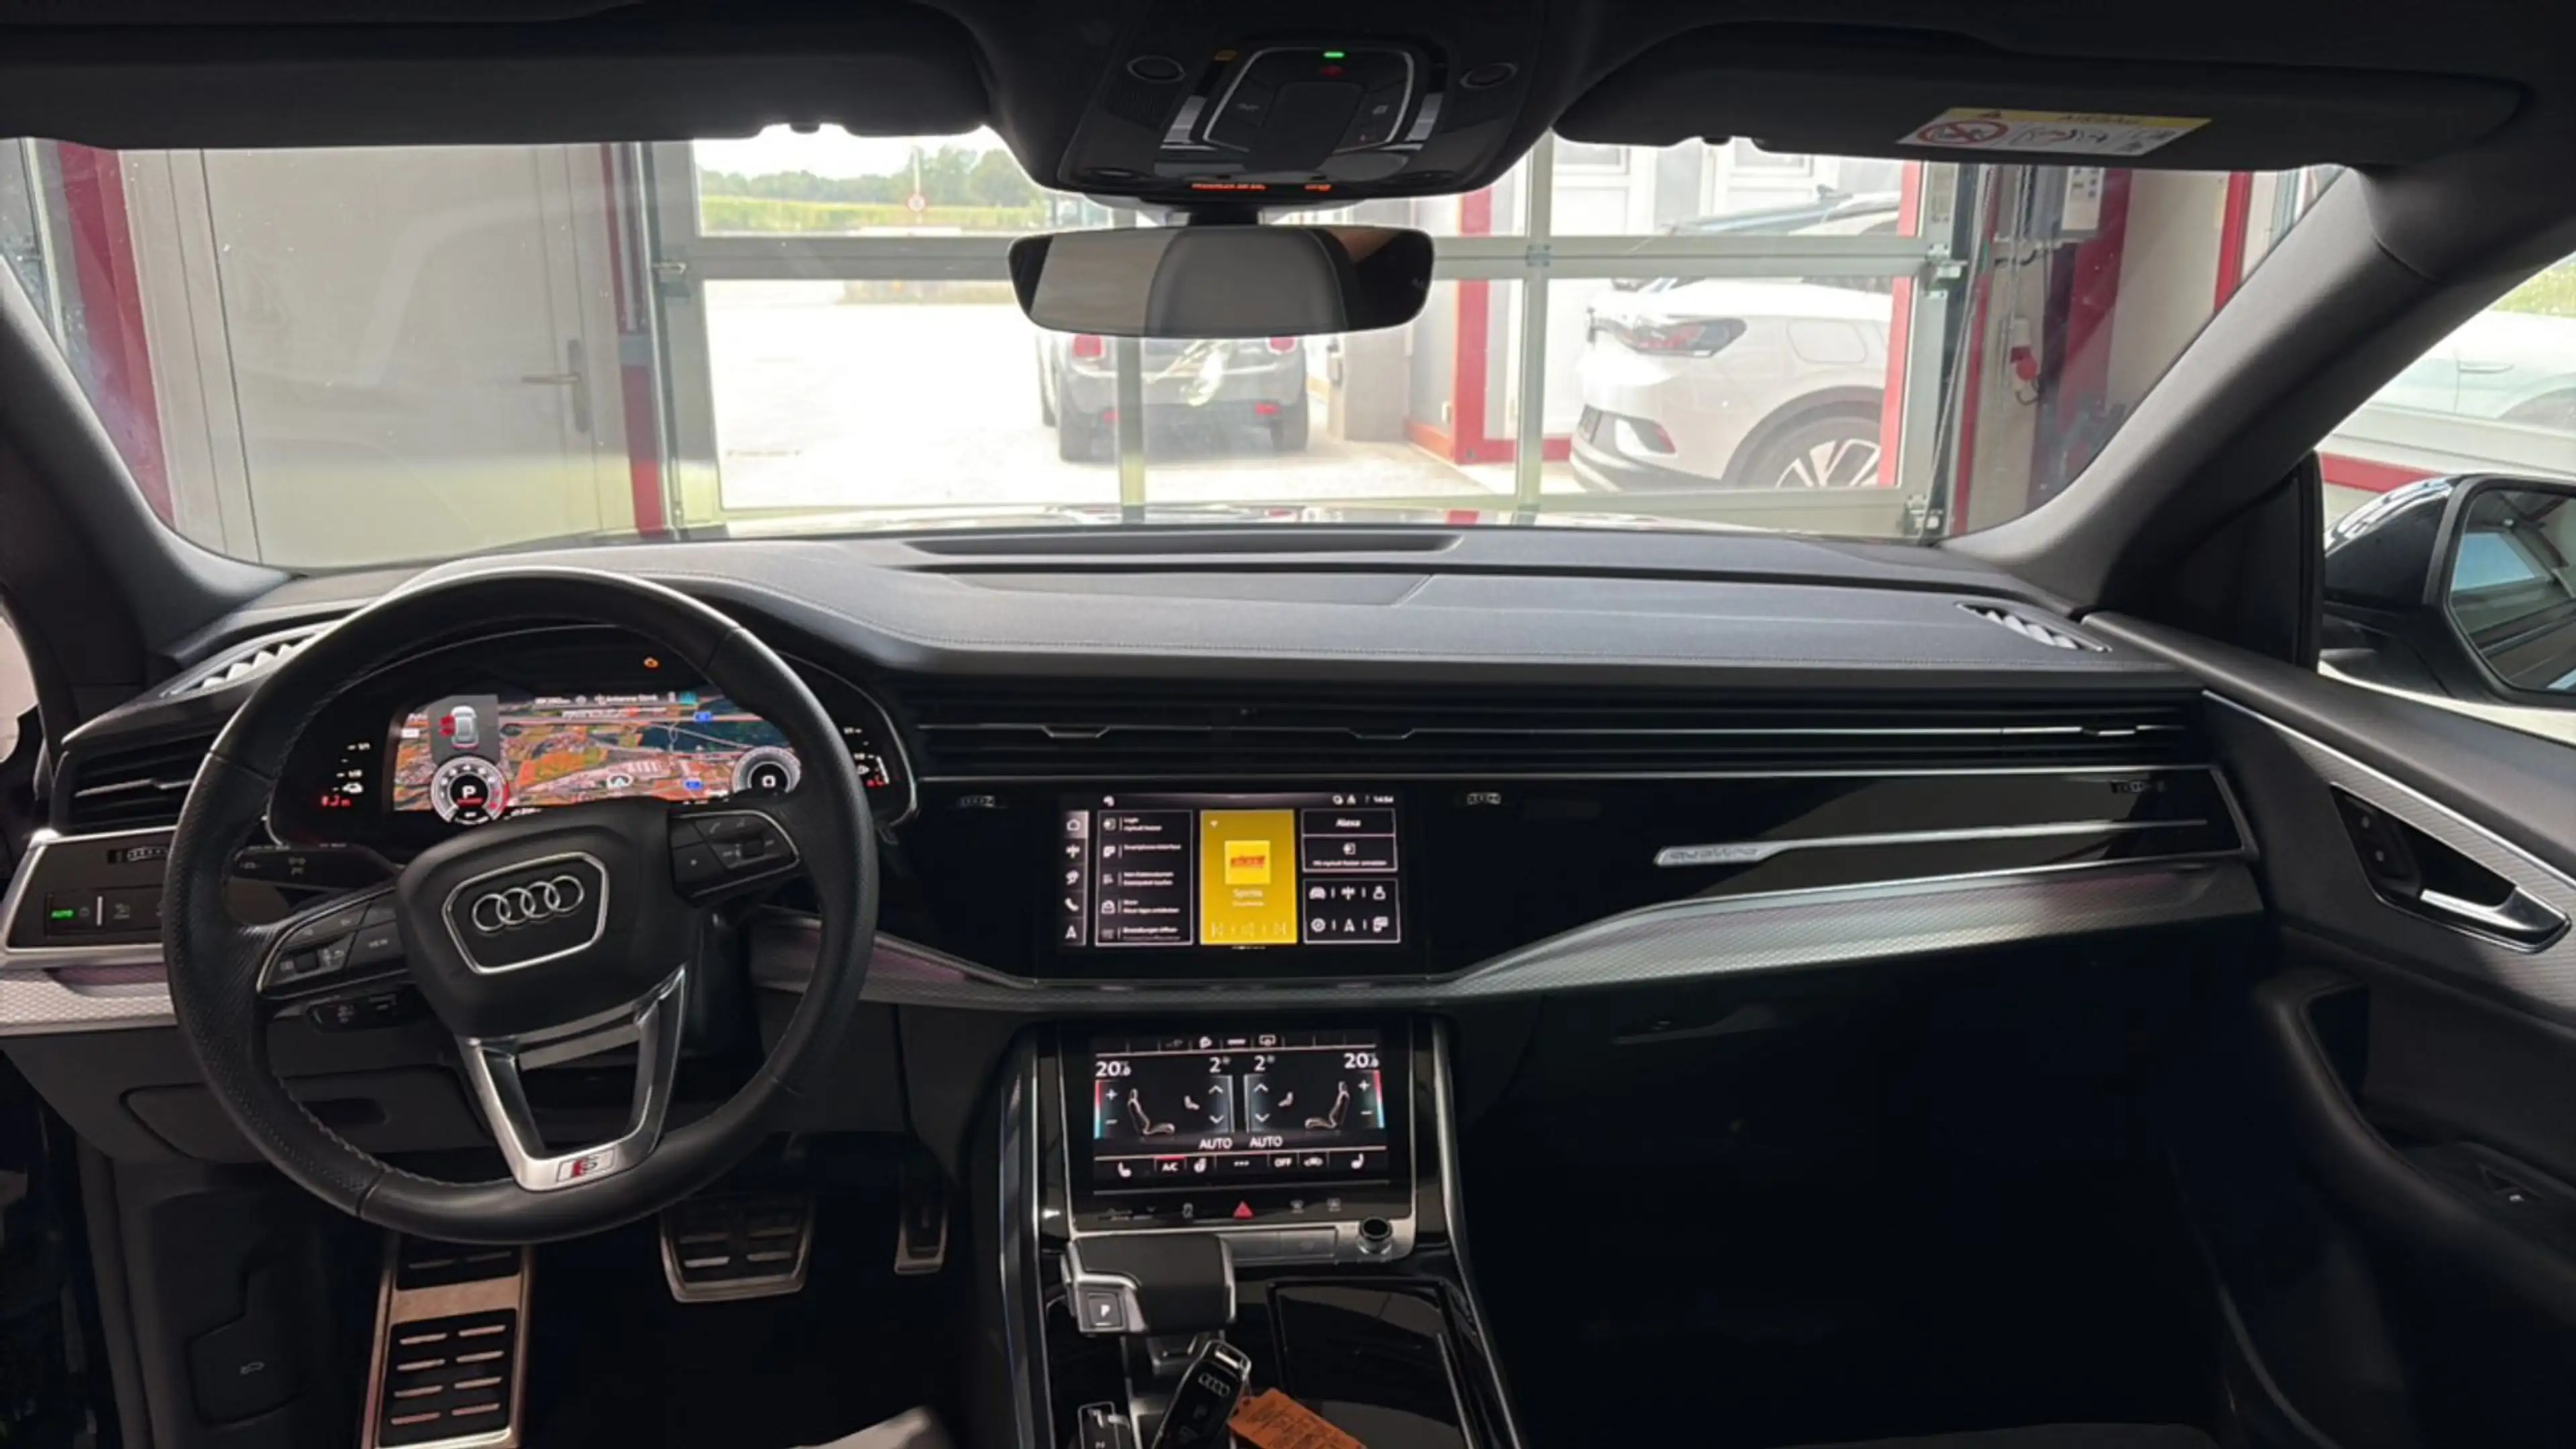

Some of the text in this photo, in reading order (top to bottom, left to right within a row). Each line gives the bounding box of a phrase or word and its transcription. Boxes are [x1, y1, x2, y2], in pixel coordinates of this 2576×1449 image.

[462, 785, 477, 799] P
[1198, 1138, 1233, 1150] AUTO
[1249, 1135, 1283, 1148] AUTO
[1274, 1157, 1292, 1167] OFF
[1100, 1304, 1111, 1318] P
